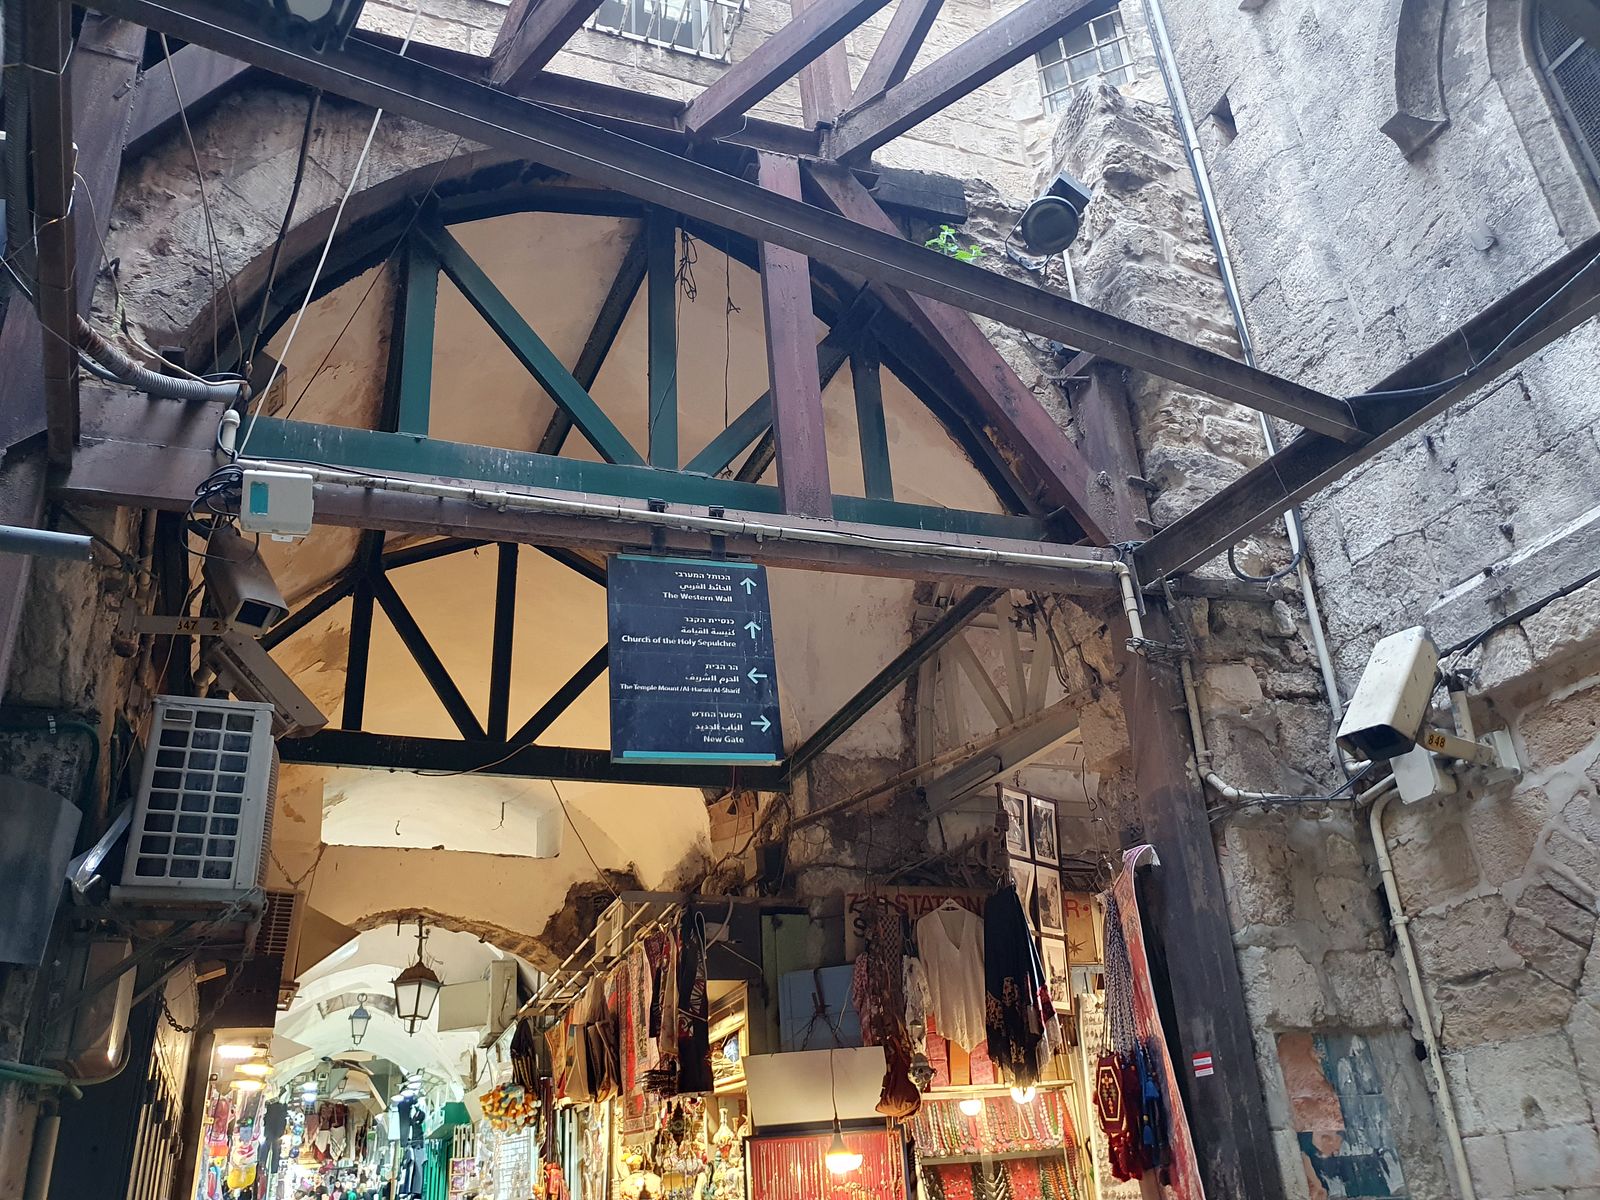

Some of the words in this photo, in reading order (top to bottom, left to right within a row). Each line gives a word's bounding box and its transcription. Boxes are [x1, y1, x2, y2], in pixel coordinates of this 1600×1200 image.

[674, 571, 705, 579] המערבי
[707, 573, 730, 581] הכותל
[680, 583, 706, 592] الغربي
[680, 593, 714, 601] Western
[680, 626, 709, 635] القيامة
[711, 628, 736, 637] كنيسة
[621, 635, 651, 643] Church
[653, 636, 661, 644] of
[663, 636, 676, 644] the
[678, 638, 696, 647] Holy
[698, 639, 736, 648] Sepulchre
[685, 672, 717, 682] الشريف
[719, 676, 739, 685] الحرم
[634, 684, 657, 692] Temple
[695, 723, 720, 732] الجديد
[721, 724, 743, 733] الباب
[703, 735, 722, 743] New
[1428, 734, 1446, 748] 848
